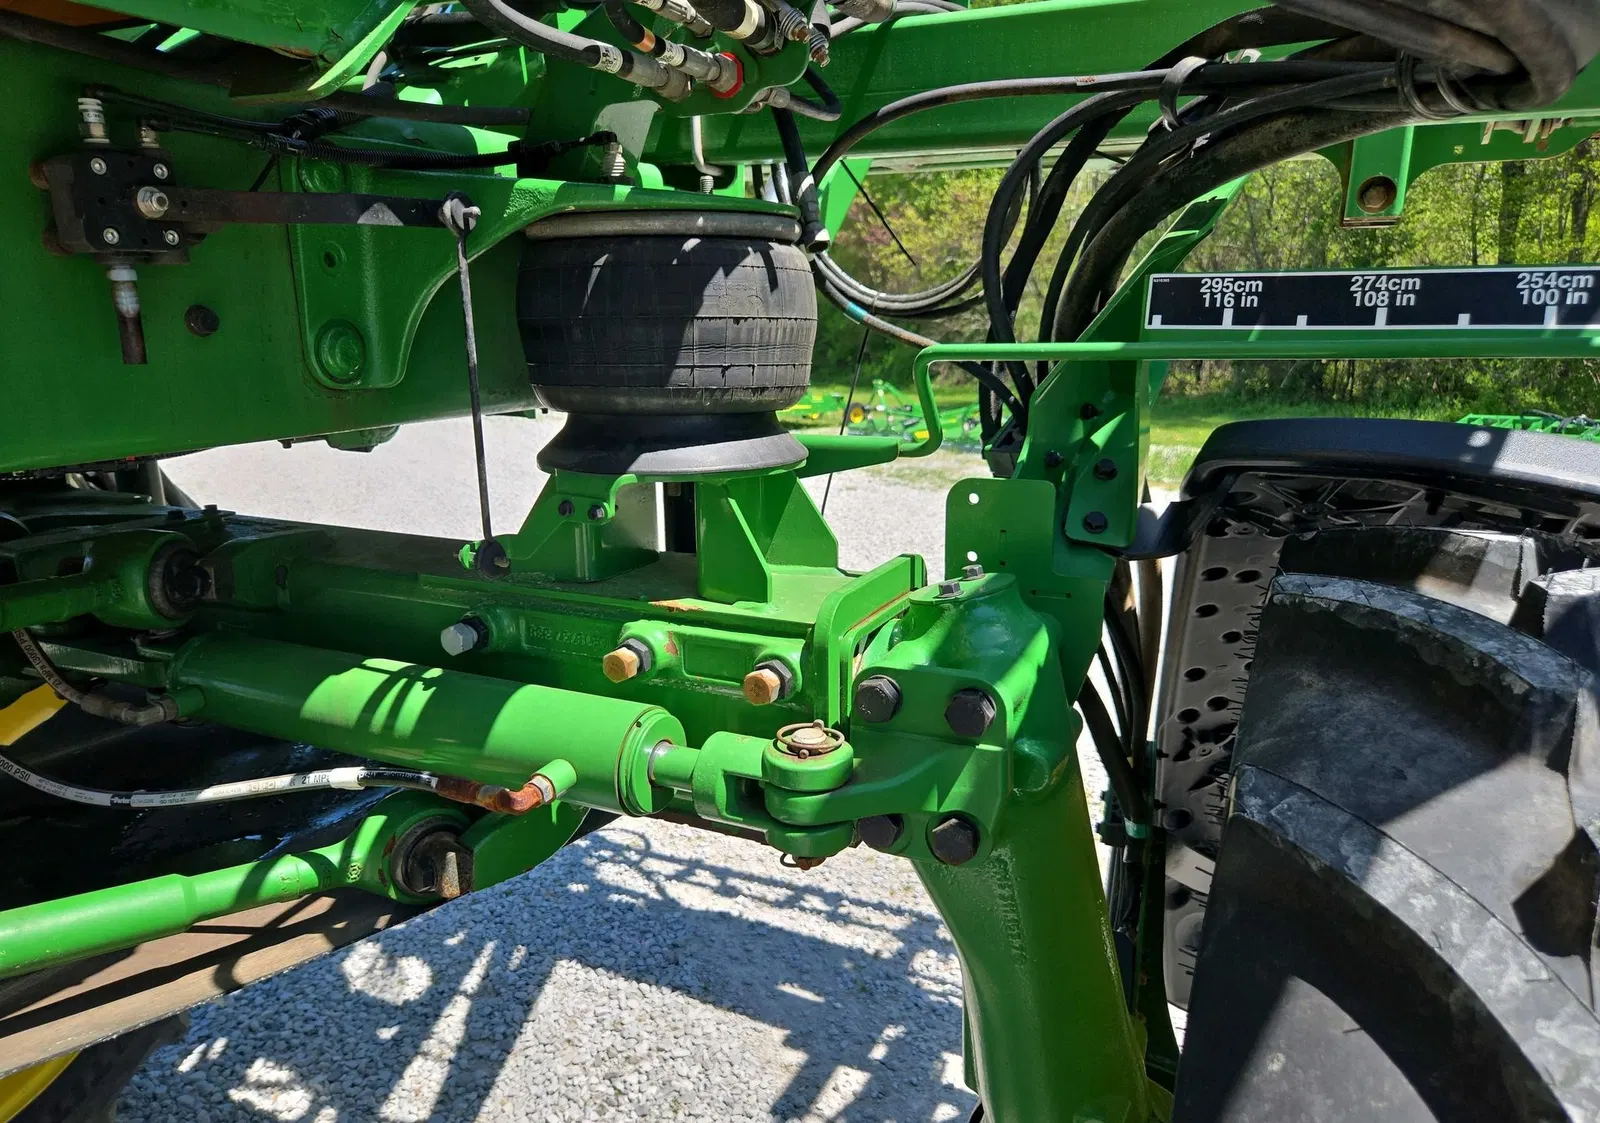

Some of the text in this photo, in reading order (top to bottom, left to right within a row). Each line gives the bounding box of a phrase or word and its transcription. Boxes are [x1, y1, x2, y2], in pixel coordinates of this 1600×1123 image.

[1199, 277, 1263, 293] 295cm
[1349, 275, 1421, 293] 274cm
[1515, 273, 1594, 291] 254cm
[1202, 292, 1259, 308] 116 in
[1352, 291, 1416, 307] 108 in
[1519, 288, 1589, 306] 100 in
[301, 775, 311, 785] 21
